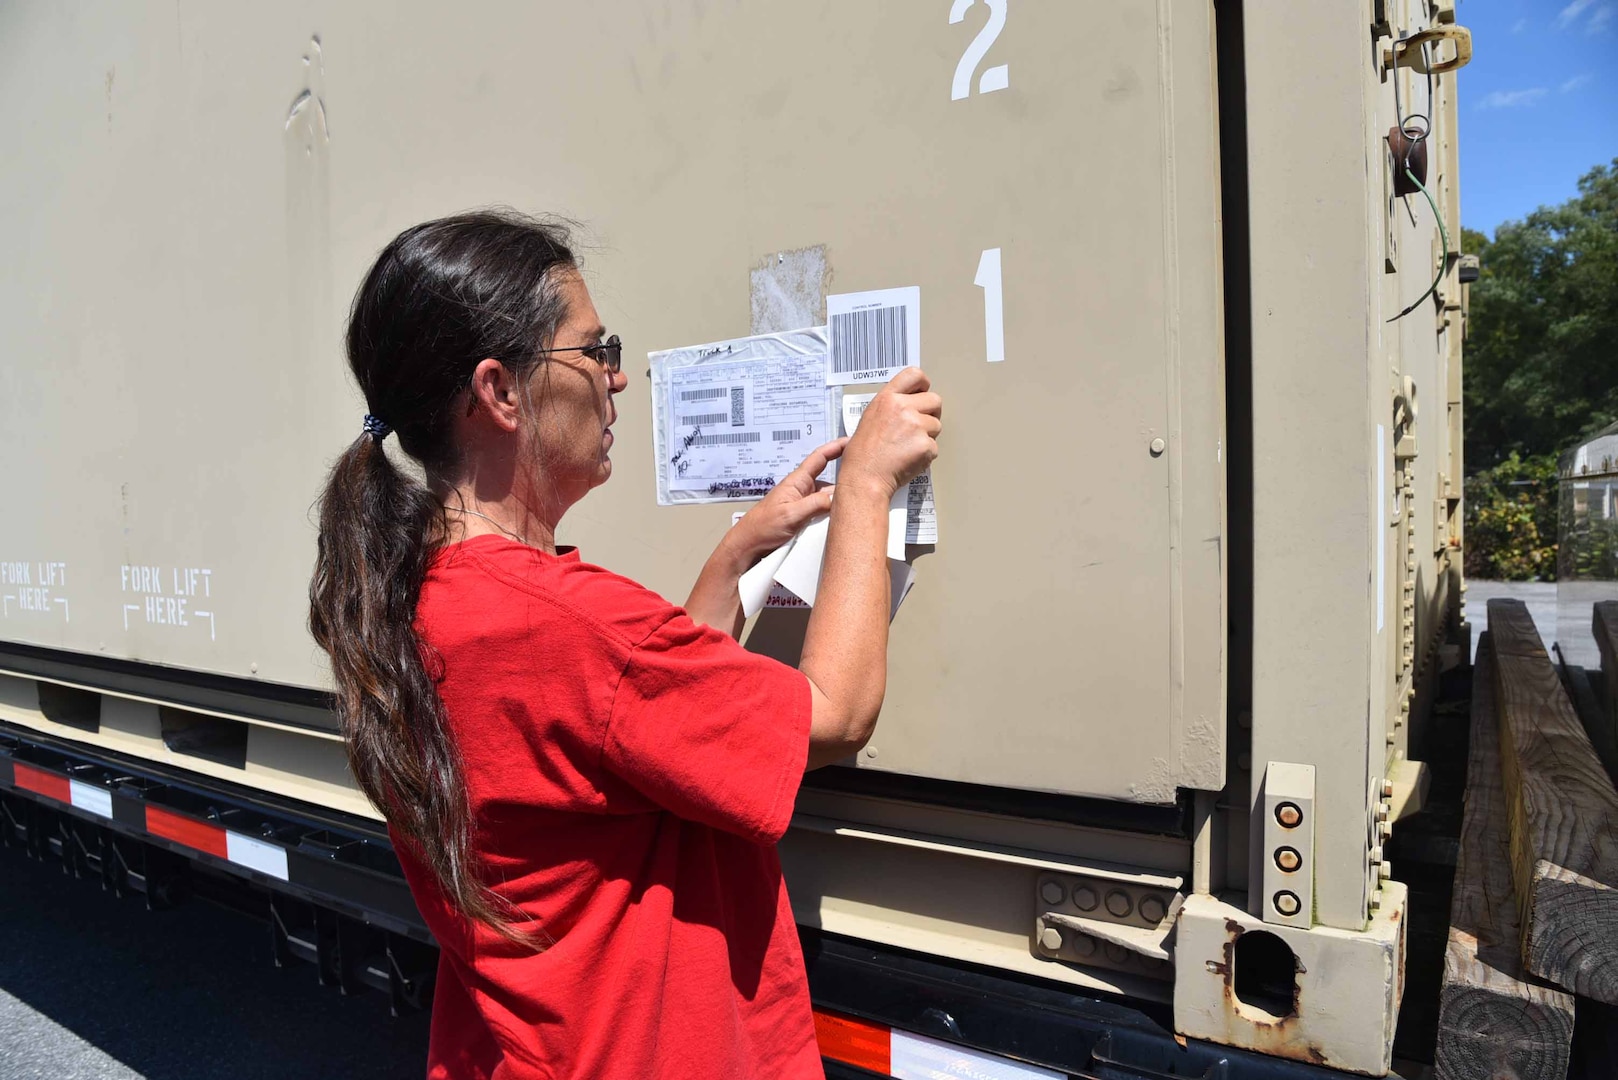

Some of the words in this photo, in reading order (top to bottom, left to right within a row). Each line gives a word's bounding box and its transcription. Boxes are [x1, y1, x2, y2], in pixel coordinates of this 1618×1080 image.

[948, 0, 1009, 101] 2
[974, 247, 1005, 363] 1
[853, 369, 889, 380] UDW37WF
[806, 424, 813, 436] 3
[1, 562, 31, 585] FORK
[38, 562, 66, 586] LIFT
[121, 565, 162, 593] FORK
[173, 567, 212, 597] LIFT
[19, 587, 51, 611] HERE
[145, 596, 189, 626] HERE
